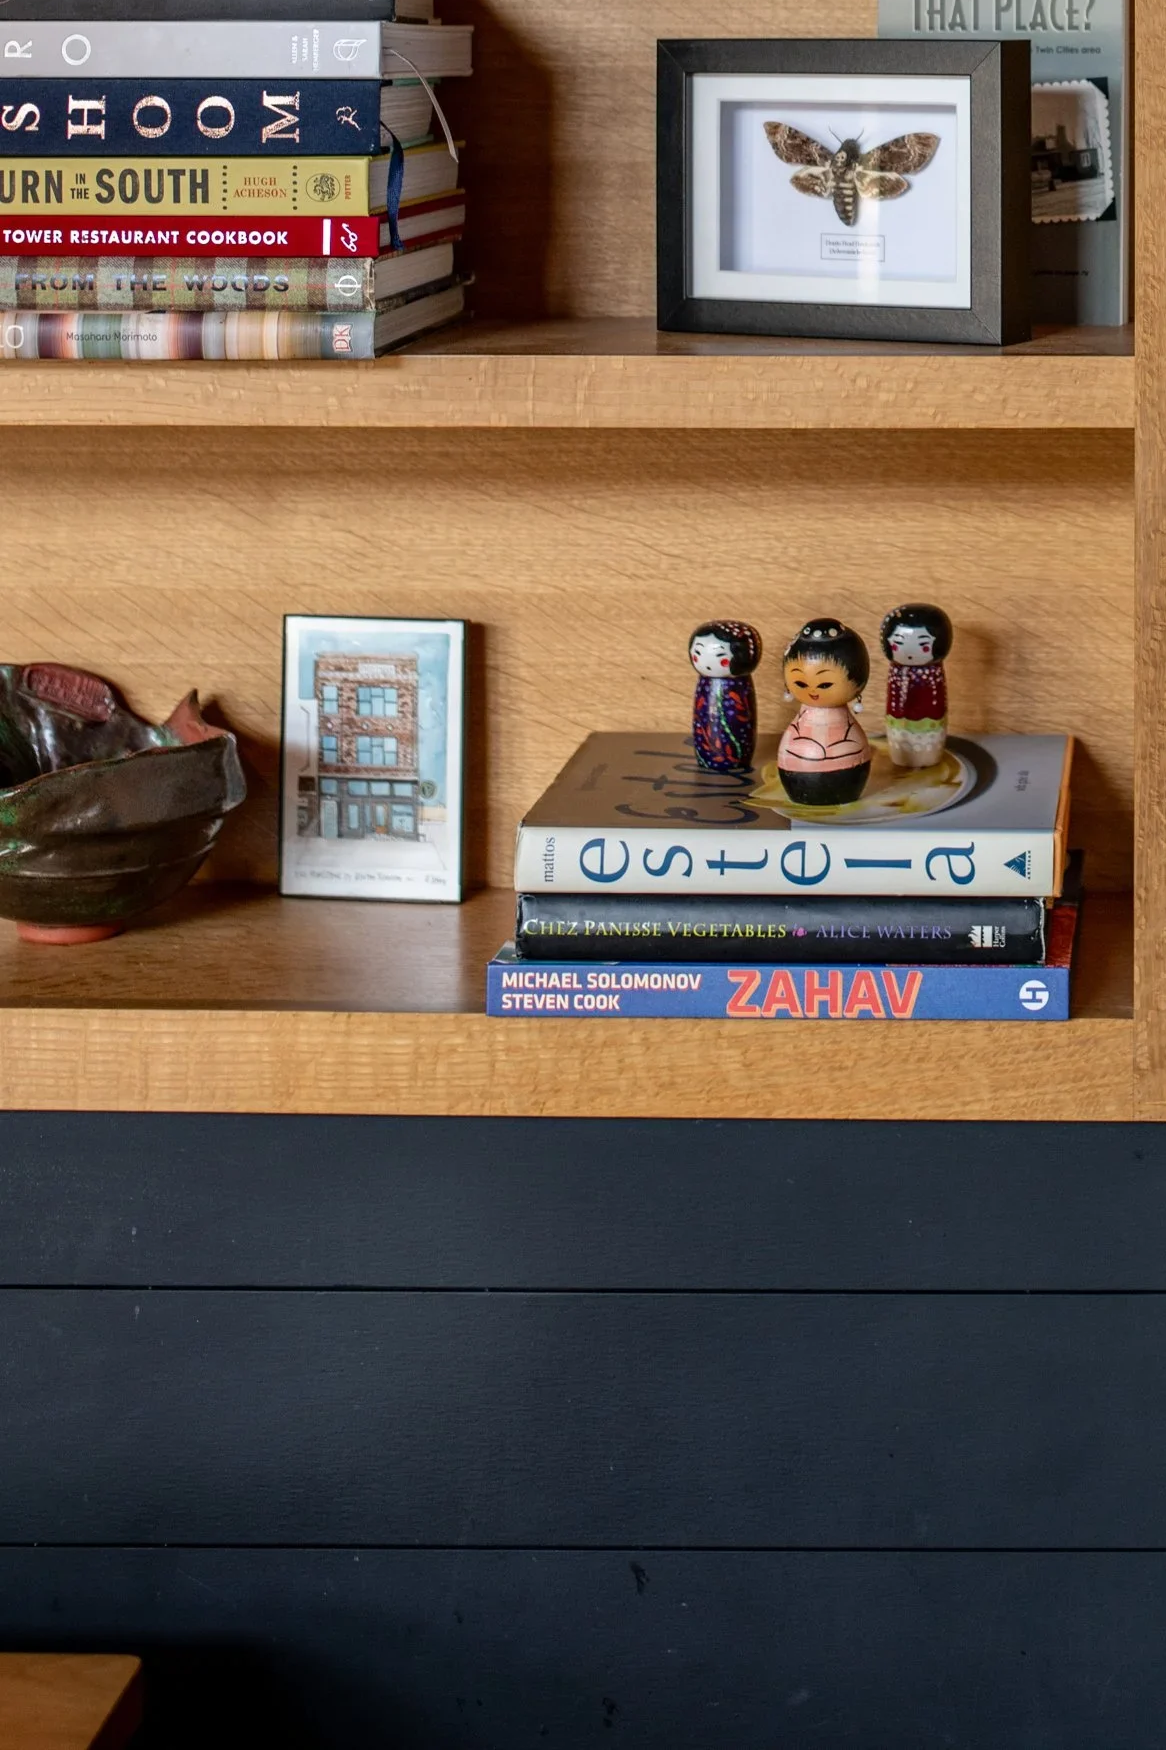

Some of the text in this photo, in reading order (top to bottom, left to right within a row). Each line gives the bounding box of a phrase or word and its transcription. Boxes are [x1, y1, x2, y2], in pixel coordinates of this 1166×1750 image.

[312, 29, 320, 71] HEMBERGER
[1035, 46, 1102, 55] Twin Cities area
[75, 173, 86, 185] IN
[95, 168, 210, 204] SOUTH
[243, 177, 278, 187] HUGH
[70, 187, 90, 200] THE
[233, 188, 287, 199] ACHESON
[3, 229, 288, 245] TOWER RESTAURANT COOKBOOK
[14, 273, 290, 293] FROM THE WOODS
[66, 331, 158, 343] Masaharu Morimoto
[543, 836, 556, 883] mattos
[579, 838, 976, 886] estela
[523, 918, 952, 939] CHEZ PANISSE VEGETABLES ALICE WATERS
[992, 926, 1000, 948] Harper
[501, 972, 702, 990] MICHAEL SOLOMONOV
[501, 994, 620, 1010] STEVEN COOK
[726, 970, 923, 1018] ZAHAV
